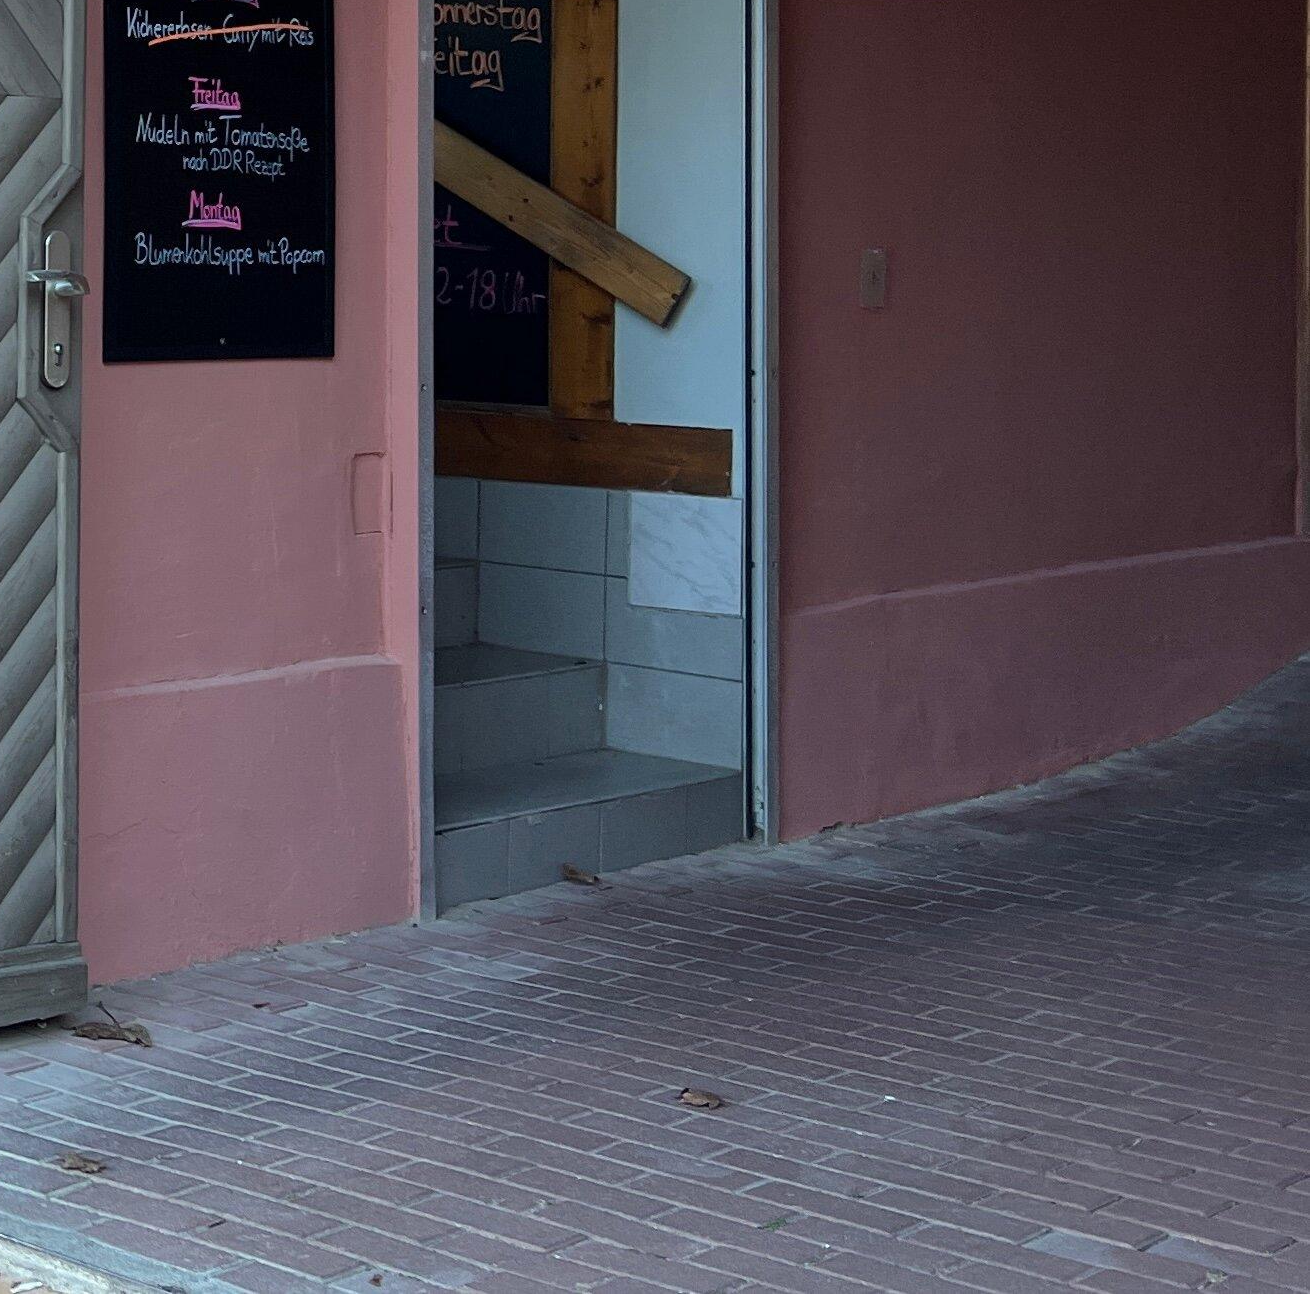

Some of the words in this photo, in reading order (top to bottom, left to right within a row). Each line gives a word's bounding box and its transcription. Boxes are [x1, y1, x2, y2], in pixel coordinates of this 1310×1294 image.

[188, 76, 241, 109] Freitag
[135, 112, 190, 146] Nudeln
[194, 119, 218, 144] mit
[182, 148, 209, 172] nach
[210, 147, 244, 174] DDR
[245, 149, 287, 182] Rezept
[182, 188, 243, 230] Montag
[134, 231, 255, 276] Blumenkohlsuppe
[257, 238, 280, 265] mit
[277, 236, 326, 274] Popcorn
